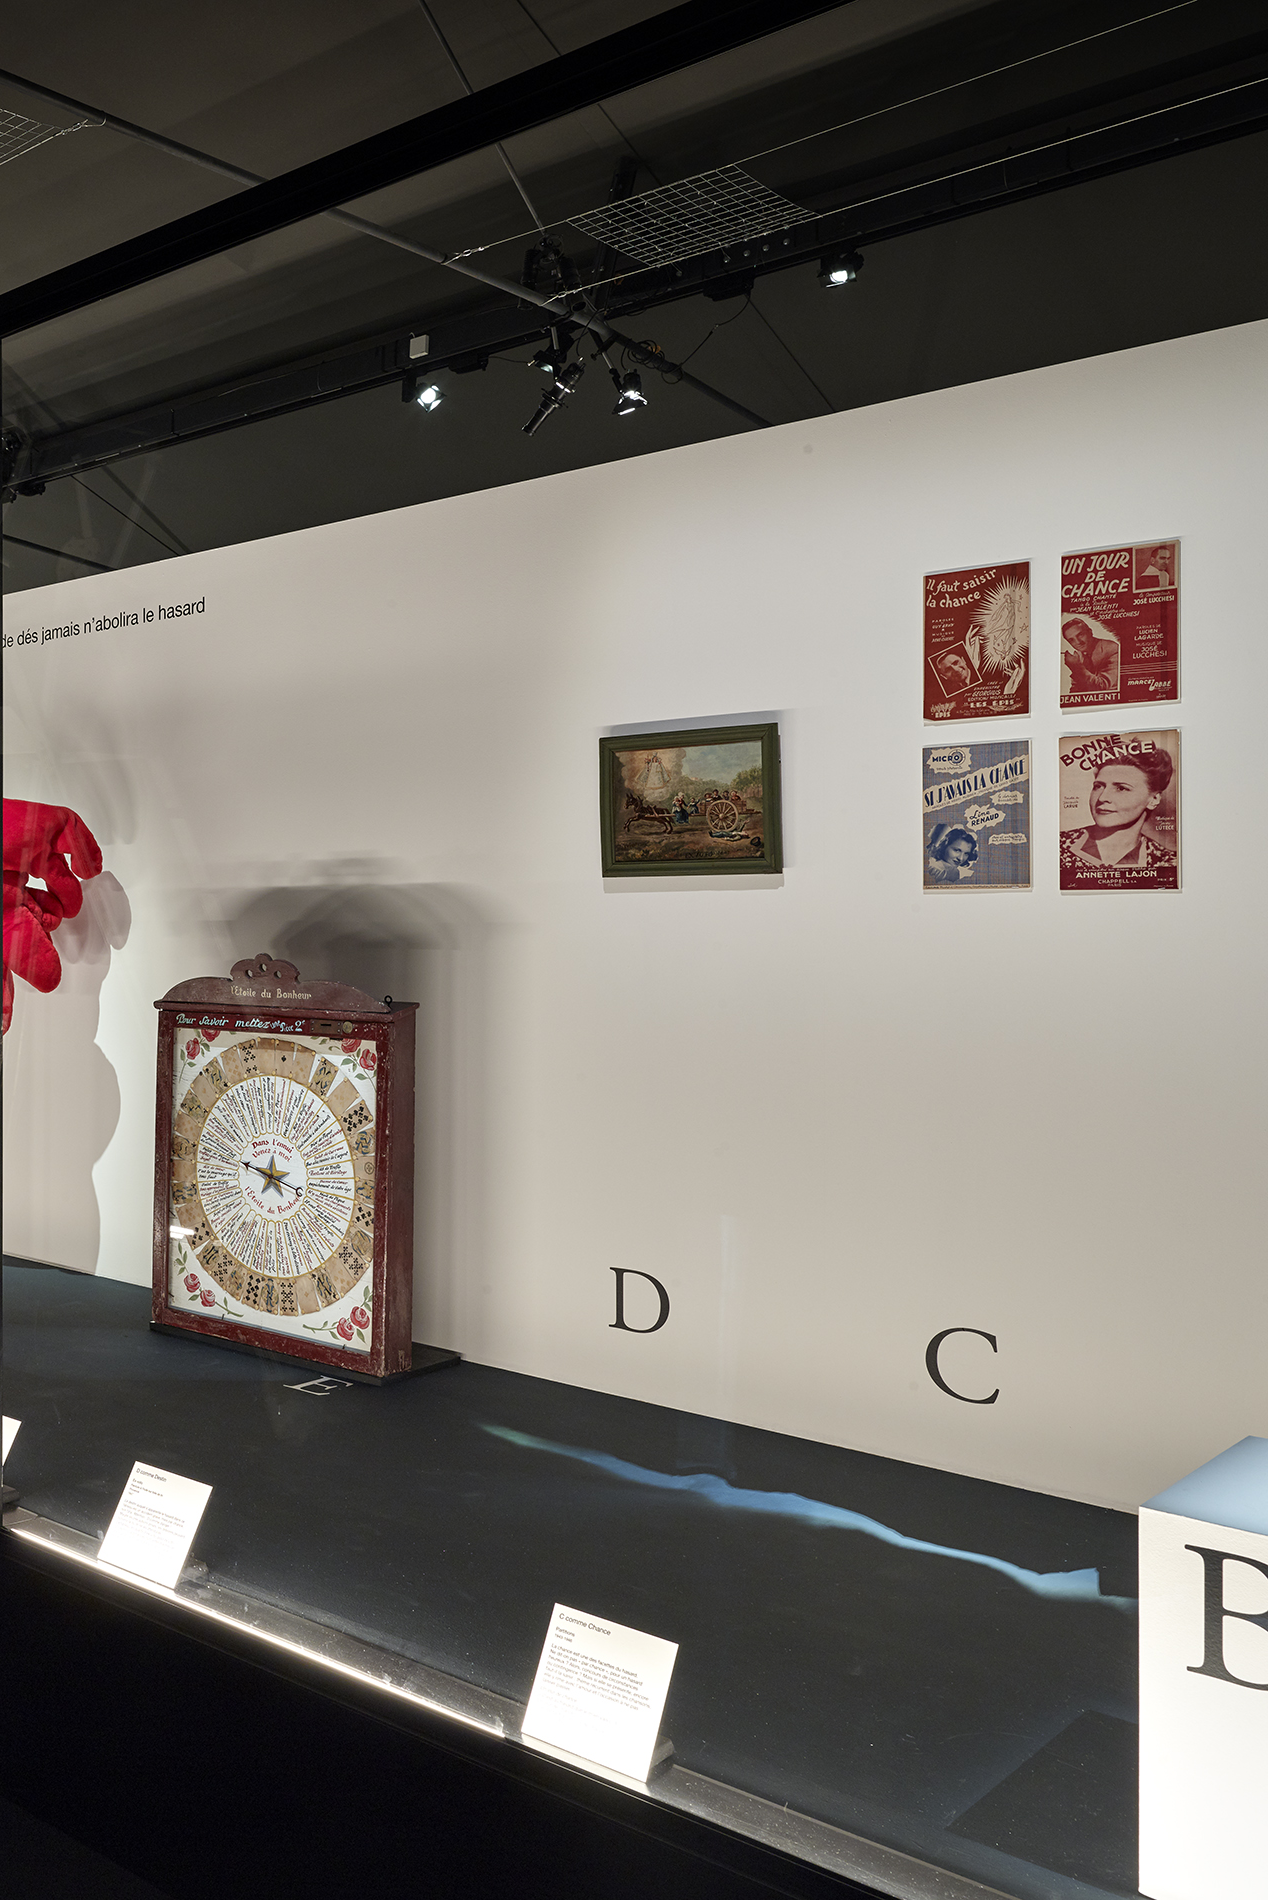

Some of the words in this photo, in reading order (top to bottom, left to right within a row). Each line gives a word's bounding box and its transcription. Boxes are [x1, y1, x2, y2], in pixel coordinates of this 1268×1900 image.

[1062, 557, 1085, 575] UN
[1087, 552, 1130, 572] JOUR
[926, 578, 935, 590] Il
[932, 580, 960, 596] faut
[963, 569, 996, 590] saisir
[1084, 570, 1106, 582] DE
[1062, 578, 1130, 598] CHANCE
[926, 594, 936, 608] la
[940, 591, 982, 608] chance
[17, 628, 38, 646] dés
[41, 620, 80, 645] jamais
[83, 612, 139, 634] n'abolira
[142, 607, 154, 624] le
[158, 597, 205, 620] hasard
[1132, 651, 1168, 659] LUCCHESI
[1060, 695, 1081, 704] JEAN
[1083, 693, 1120, 702] VALENTI
[1060, 734, 1122, 767] BONNE
[1079, 742, 1152, 771] CHANCE
[924, 790, 934, 807] SI
[937, 778, 972, 803] J'AVAIS
[974, 773, 986, 791] LA
[990, 758, 1026, 784] CHANCE
[971, 813, 999, 826] RENAUD
[1076, 871, 1121, 879] ANNETTE
[261, 989, 271, 999] du
[277, 988, 312, 1000] Bonheur
[176, 1014, 197, 1025] Pour
[235, 1020, 270, 1029] mettez
[252, 1140, 269, 1149] Dans
[252, 1148, 271, 1158] Venez
[278, 1150, 292, 1162] moi
[267, 1206, 275, 1214] du
[608, 1266, 670, 1334] D
[925, 1326, 1000, 1405] C
[283, 1375, 354, 1396] E
[565, 1616, 587, 1627] comme
[588, 1622, 611, 1635] Chance
[1184, 1544, 1268, 1692] B
[556, 1627, 575, 1636] Partitions
[590, 1664, 605, 1672] chance
